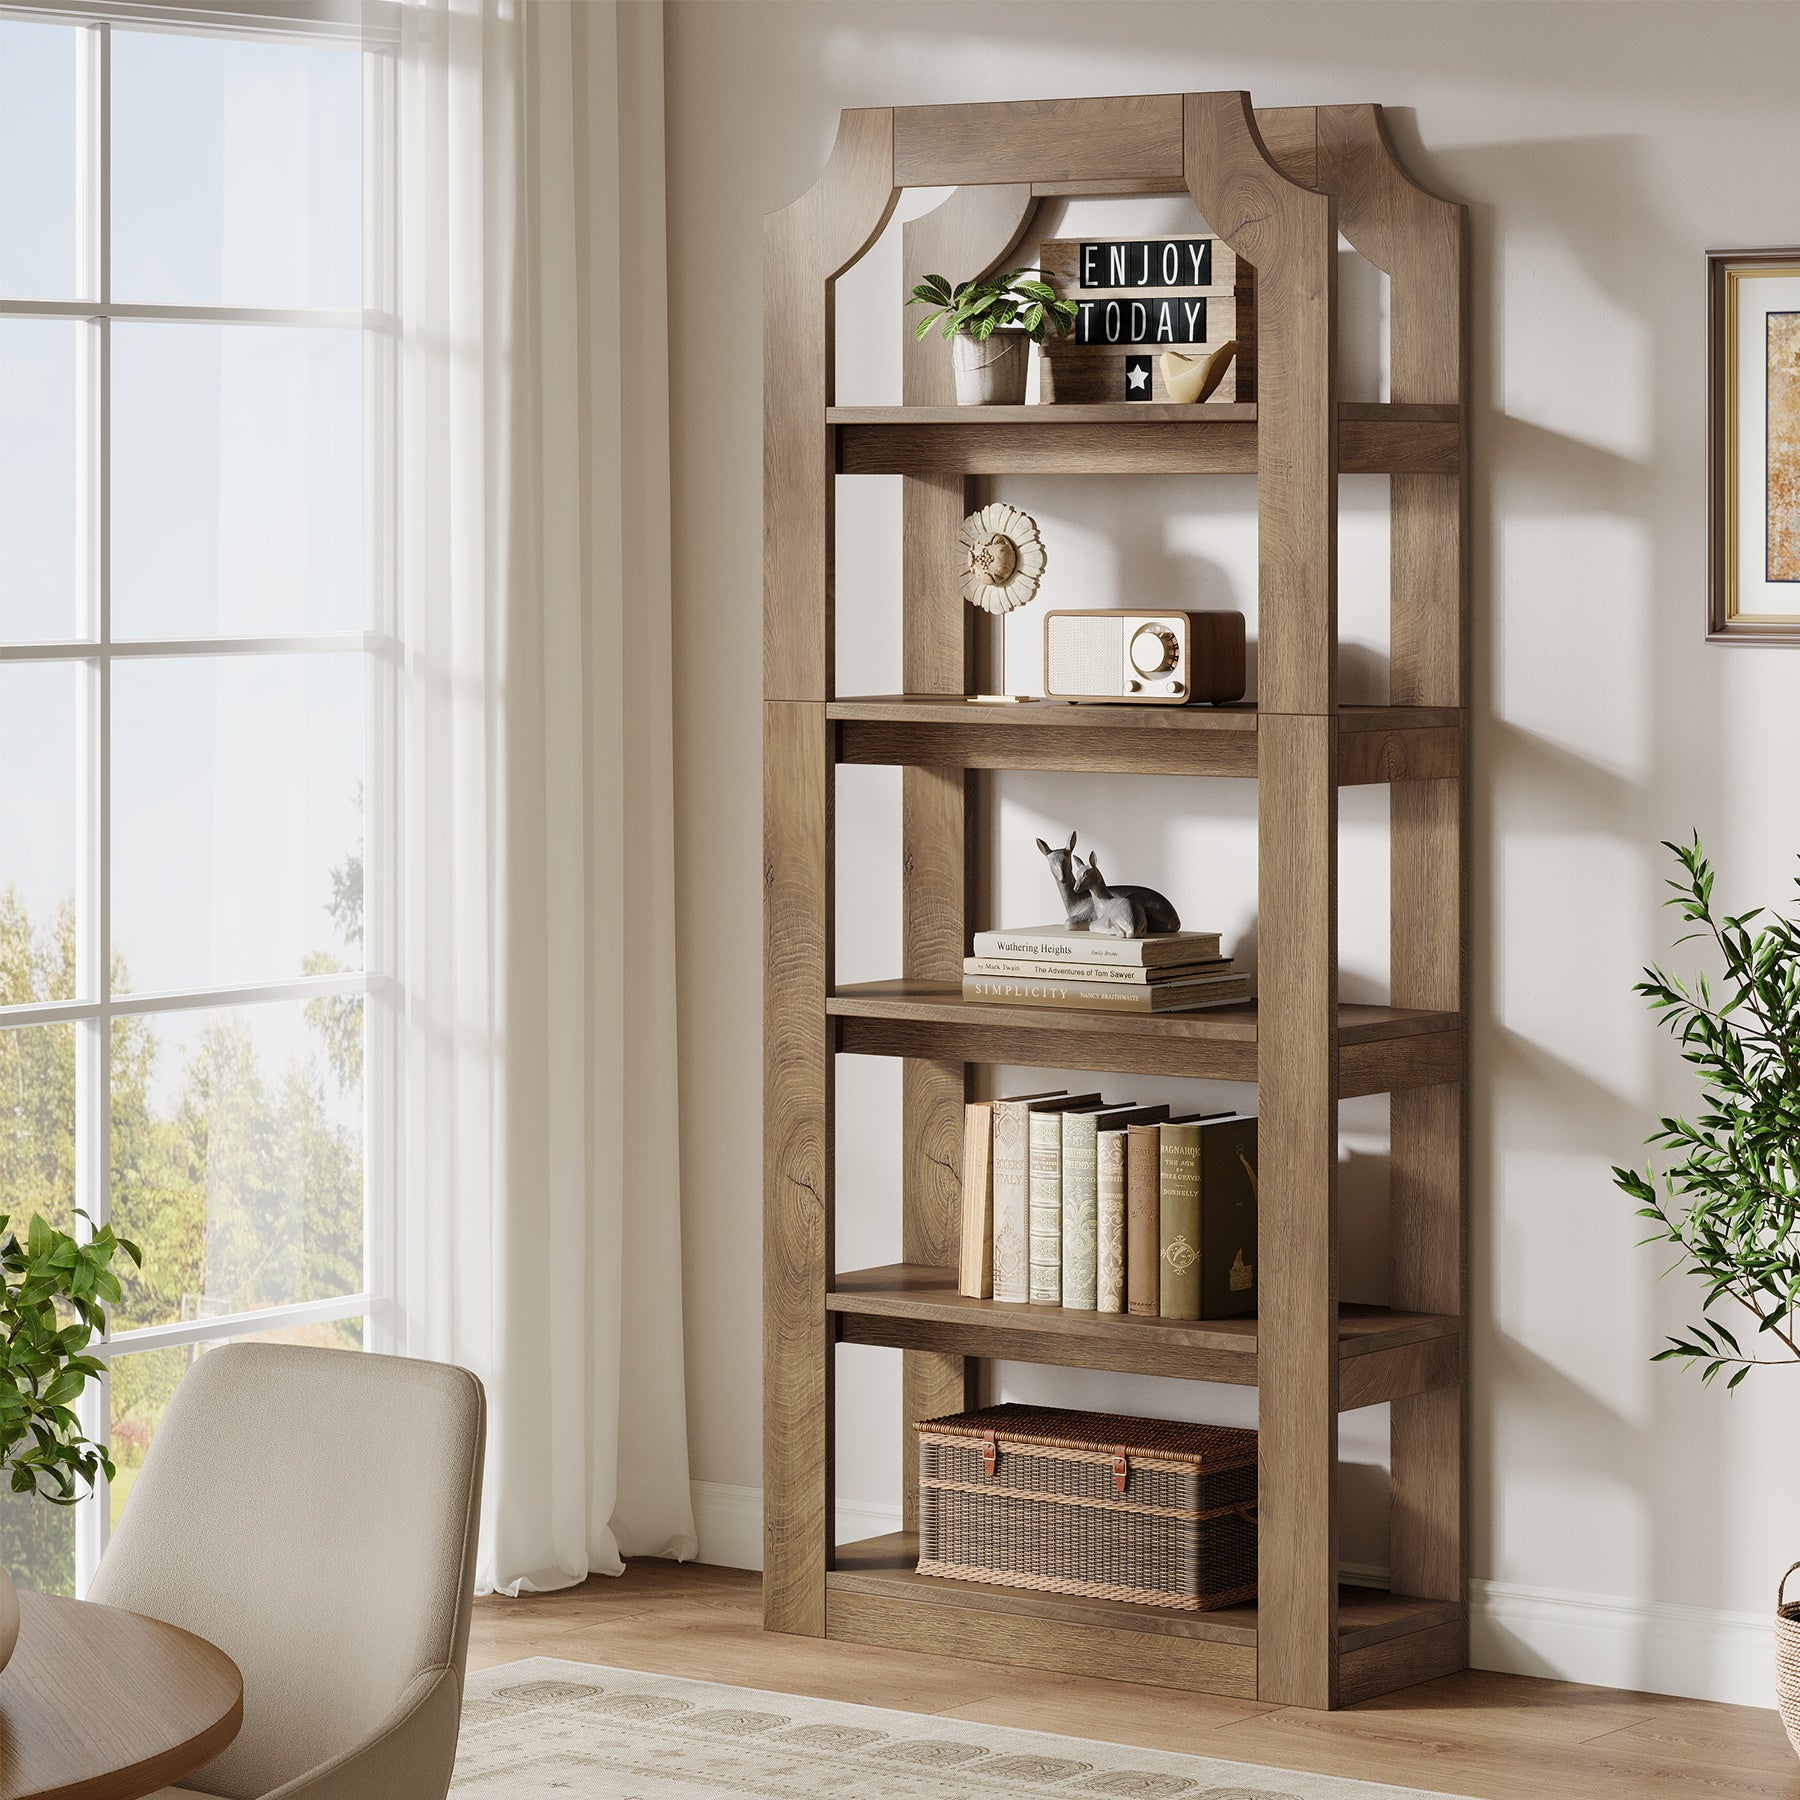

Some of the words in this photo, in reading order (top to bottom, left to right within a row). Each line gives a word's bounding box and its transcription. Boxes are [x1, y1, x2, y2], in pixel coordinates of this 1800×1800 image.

[1084, 243, 1205, 286] ENJOY
[1079, 301, 1201, 342] TODAY
[997, 941, 1039, 955] Wuthering
[1041, 944, 1072, 956] Heights
[1047, 967, 1085, 976] Adventures
[1094, 969, 1109, 977] Tom
[1109, 970, 1135, 980] Sawyer
[975, 983, 1068, 999] SIMPLICITY
[1080, 992, 1100, 1000] NANCY
